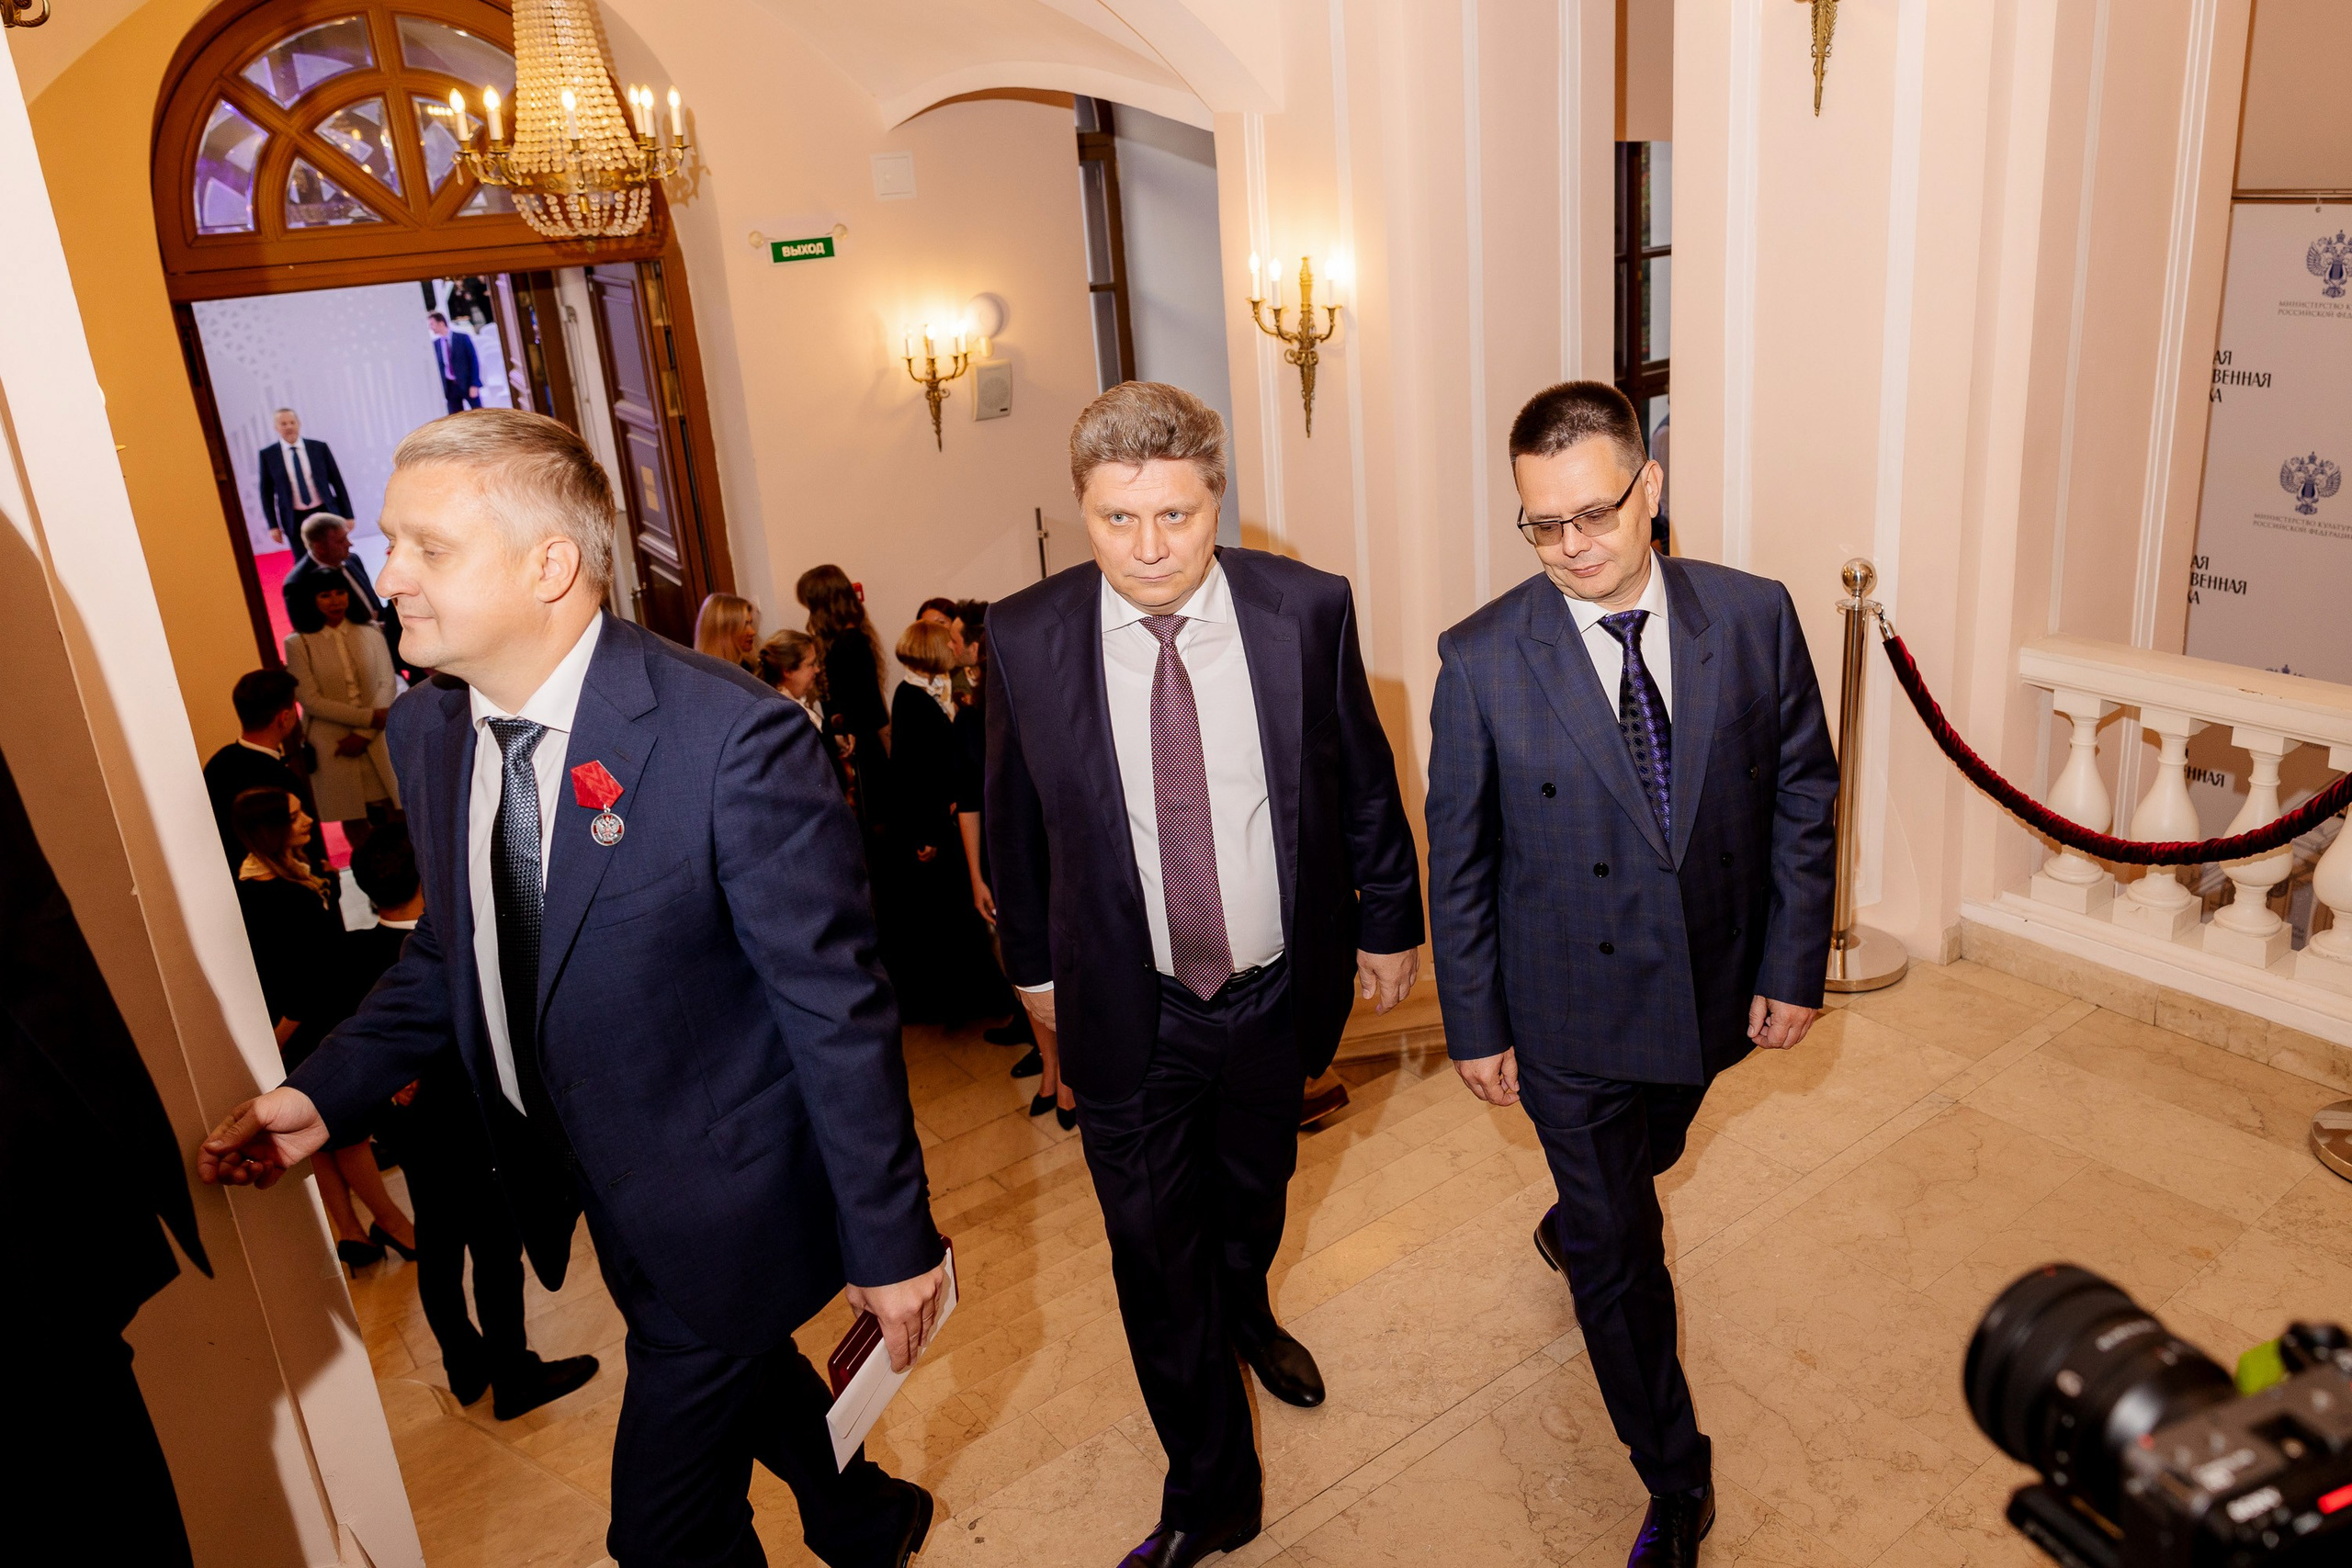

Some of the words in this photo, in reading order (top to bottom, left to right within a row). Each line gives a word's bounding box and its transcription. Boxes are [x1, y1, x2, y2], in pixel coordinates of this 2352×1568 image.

[782, 242, 825, 257] ВЫХОД
[2212, 350, 2232, 366] АЯ
[2212, 368, 2271, 388] ВЕННАЯ
[2190, 554, 2209, 570] АЯ
[2190, 571, 2247, 595] ВЕННАЯ
[2184, 765, 2224, 788] ННАЯ
